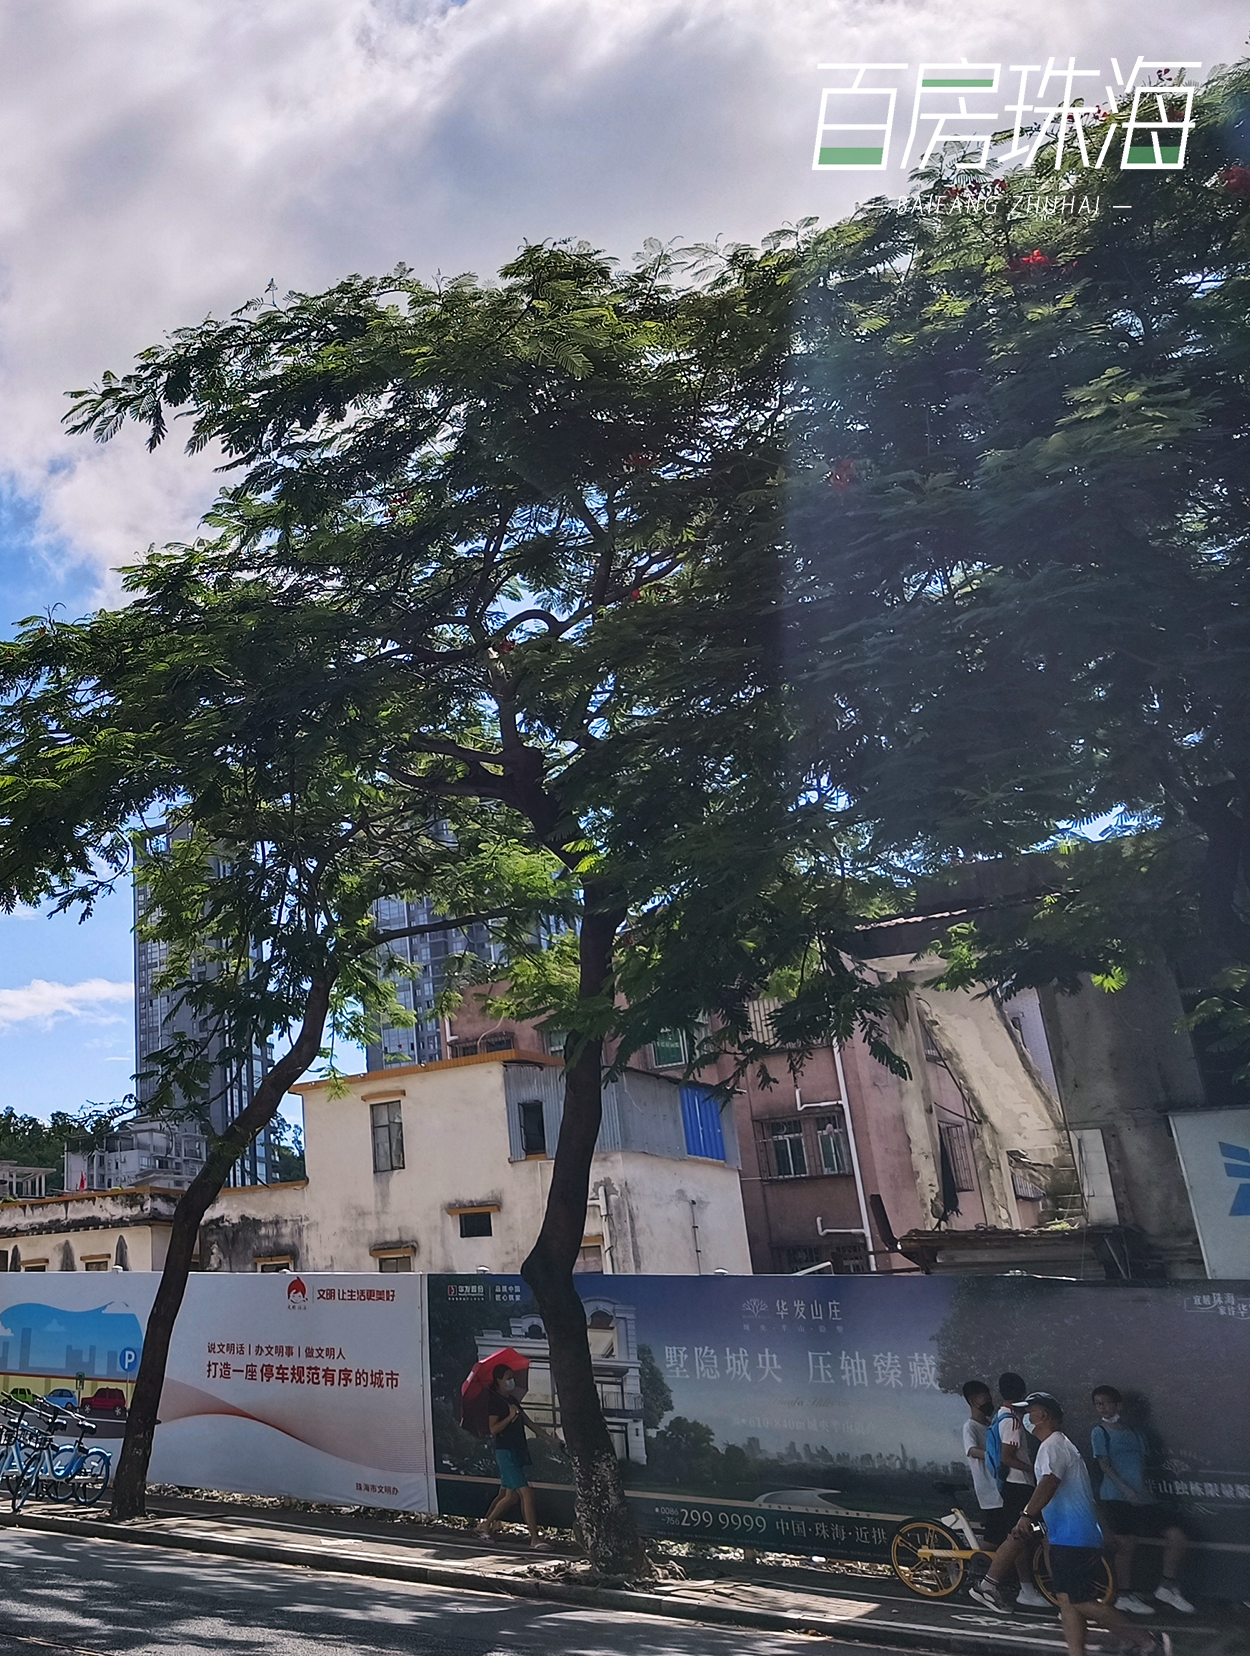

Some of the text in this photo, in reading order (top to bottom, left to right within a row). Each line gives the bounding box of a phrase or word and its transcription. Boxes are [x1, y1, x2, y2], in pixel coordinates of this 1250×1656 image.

[316, 1288, 396, 1302] 文明 让生活更美好
[775, 1299, 843, 1321] 华发山庄
[1218, 1303, 1250, 1318] 家住华
[206, 1342, 346, 1360] 说文明话 办文明事 做文明人
[206, 1360, 400, 1390] 打造一座停车规范有序的城市
[664, 1345, 941, 1390] 墅隐城央 压轴臻藏
[355, 1482, 399, 1496] 珠海市文明办
[660, 1506, 679, 1516] 0086
[680, 1508, 767, 1534] 299 9999
